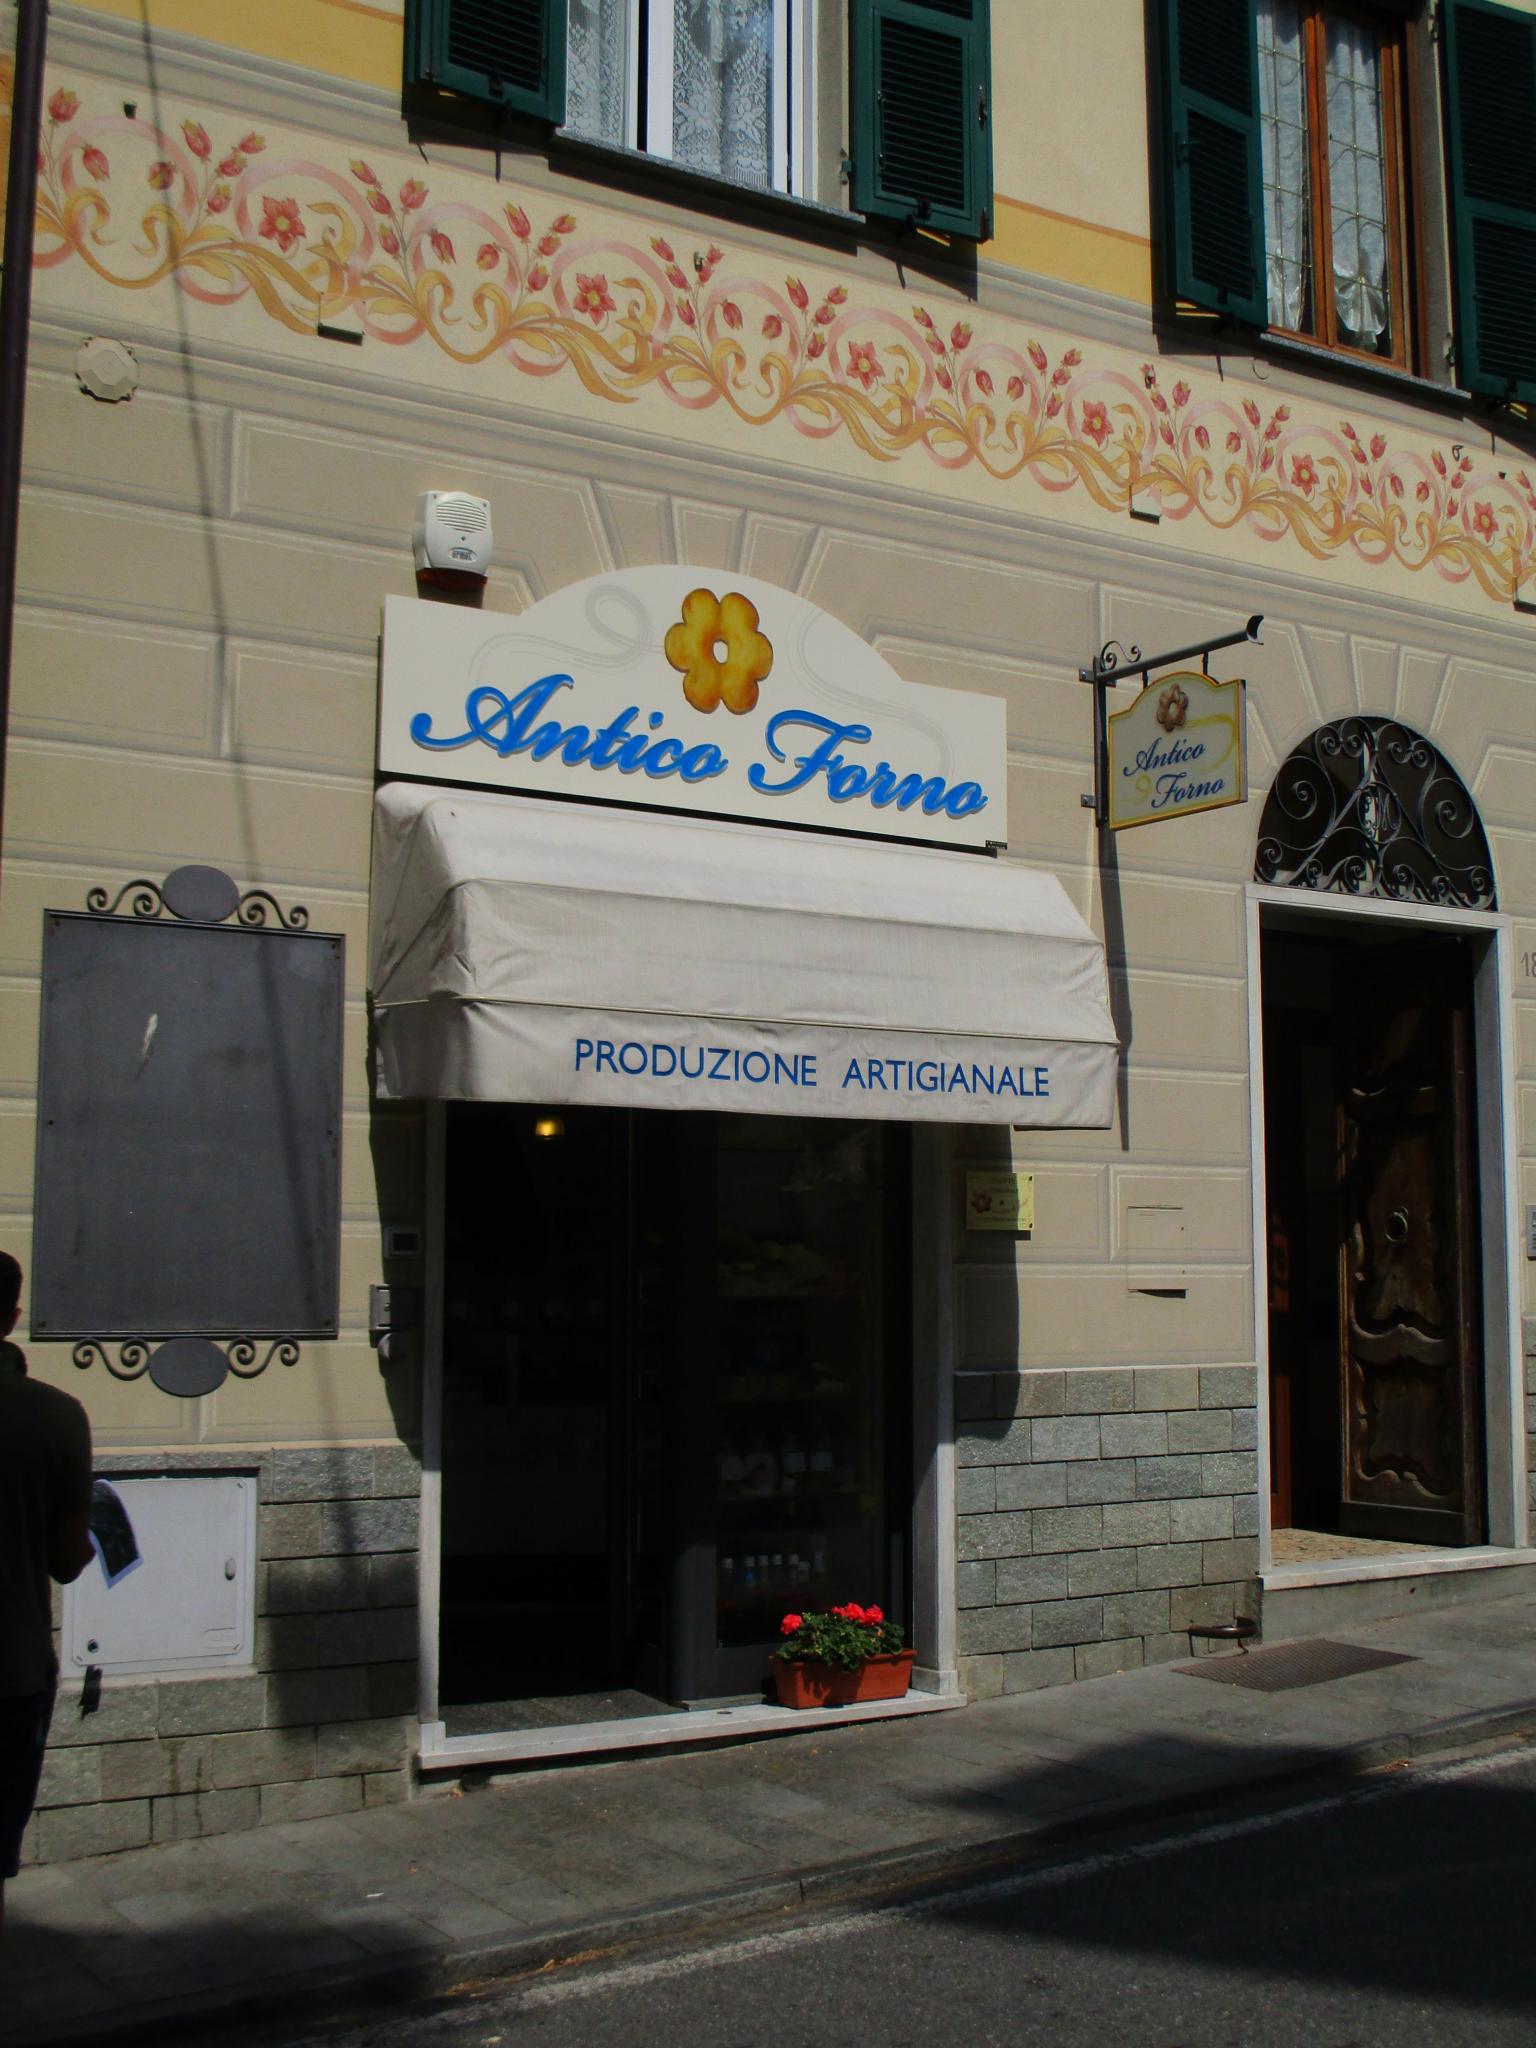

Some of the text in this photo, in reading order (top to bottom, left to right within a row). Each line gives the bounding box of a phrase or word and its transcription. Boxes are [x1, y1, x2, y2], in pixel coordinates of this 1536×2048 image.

[410, 673, 989, 819] Antico Forno
[1123, 737, 1206, 777] Antico
[1151, 771, 1225, 809] Forno
[575, 1038, 1051, 1098] PRODUZIONE ARTIGIANALE
